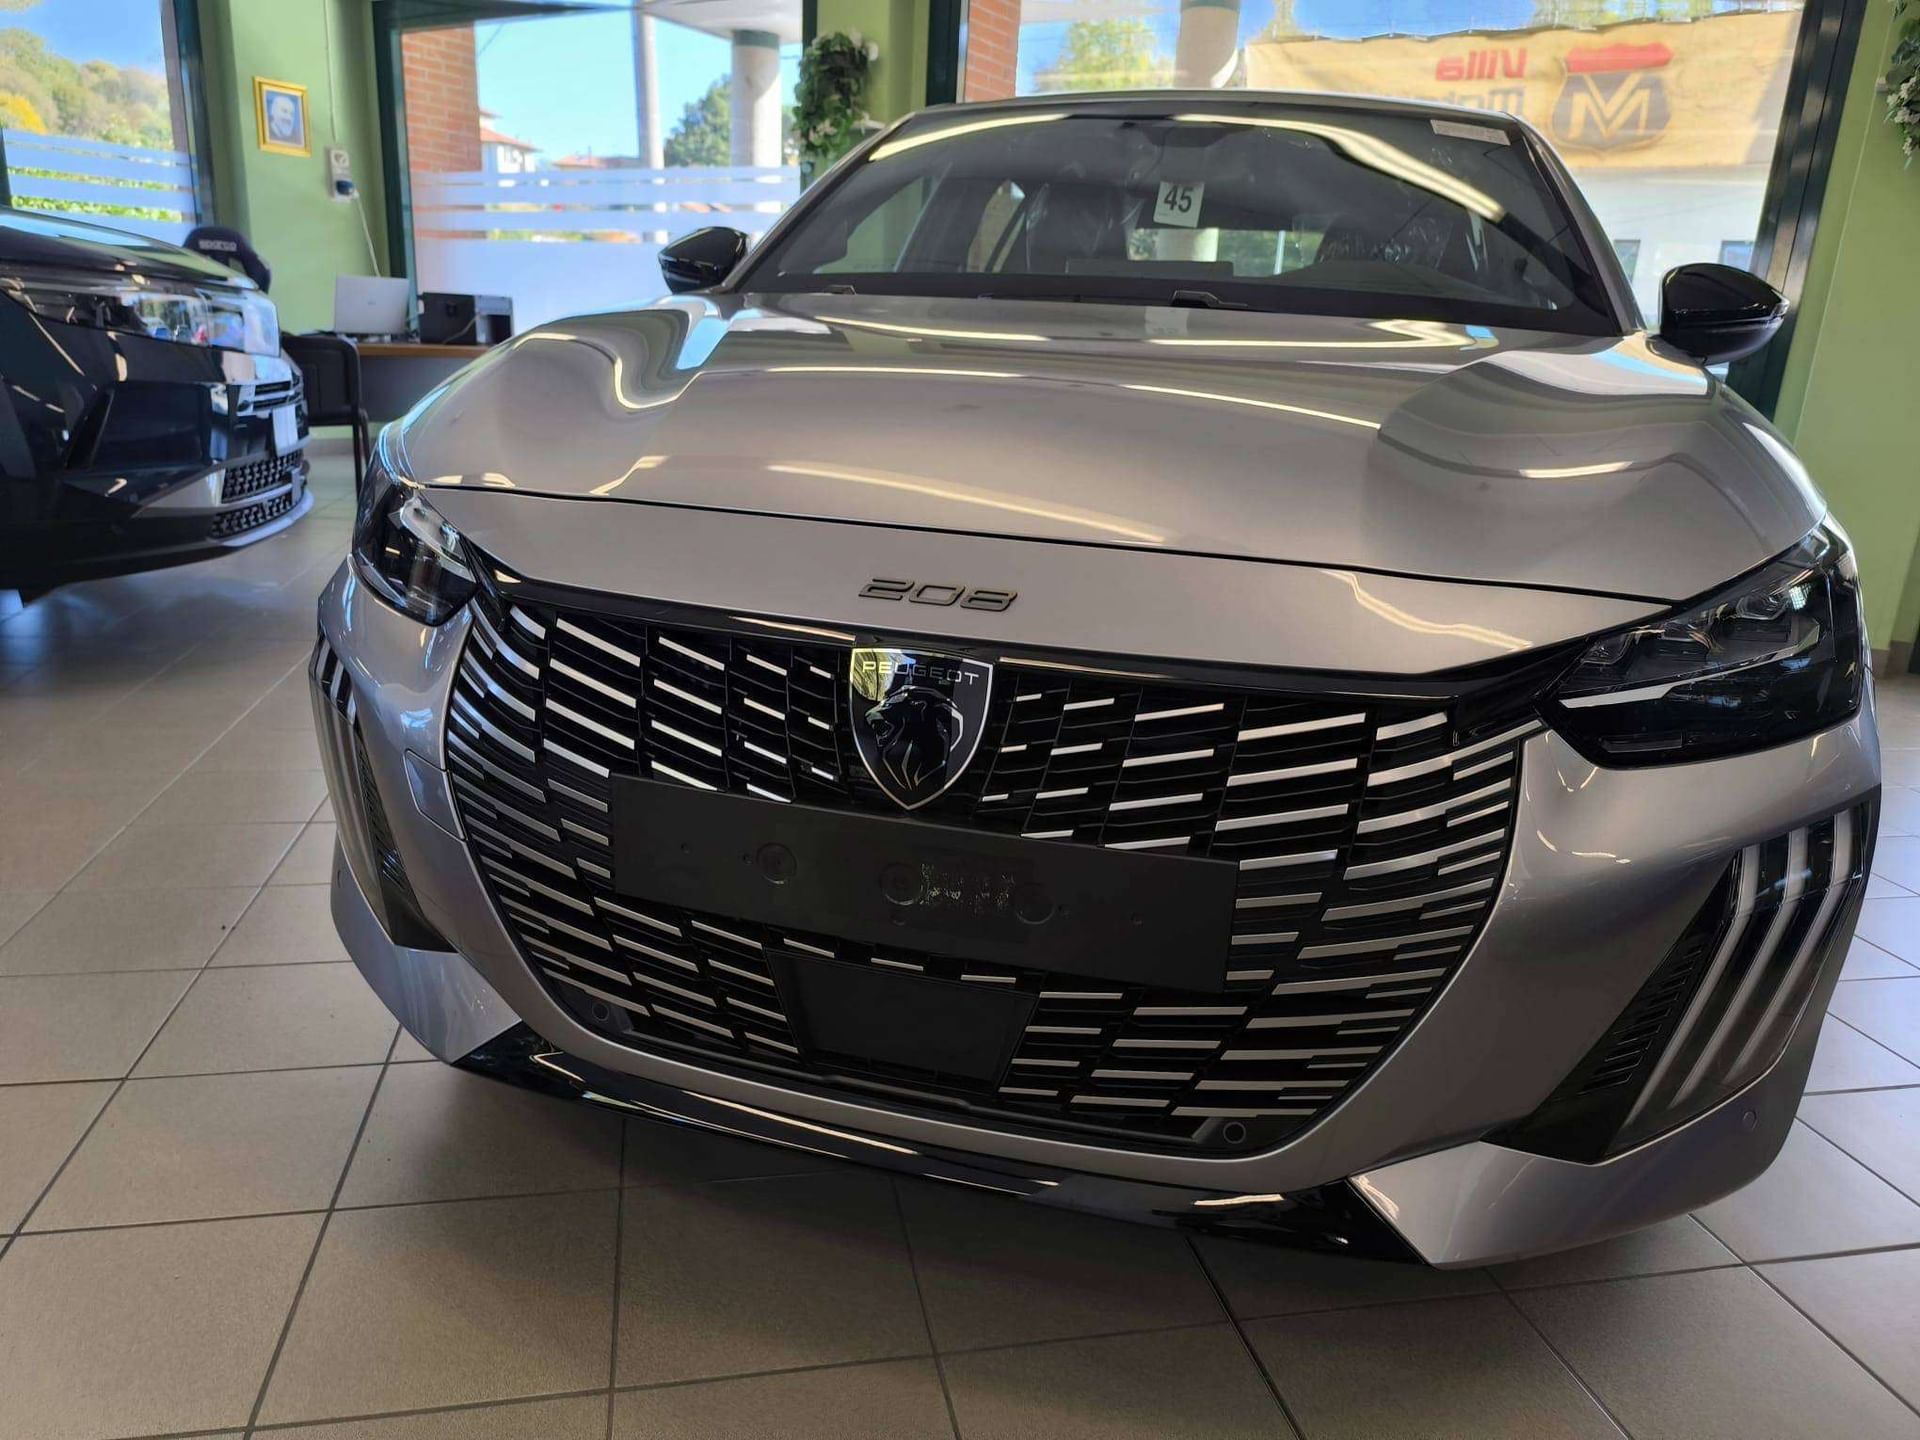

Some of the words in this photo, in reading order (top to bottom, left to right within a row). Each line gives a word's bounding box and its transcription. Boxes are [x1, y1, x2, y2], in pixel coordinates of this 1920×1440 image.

[1163, 185, 1194, 213] 45
[858, 578, 1018, 612] 208
[862, 660, 980, 686] PEUGEOT
